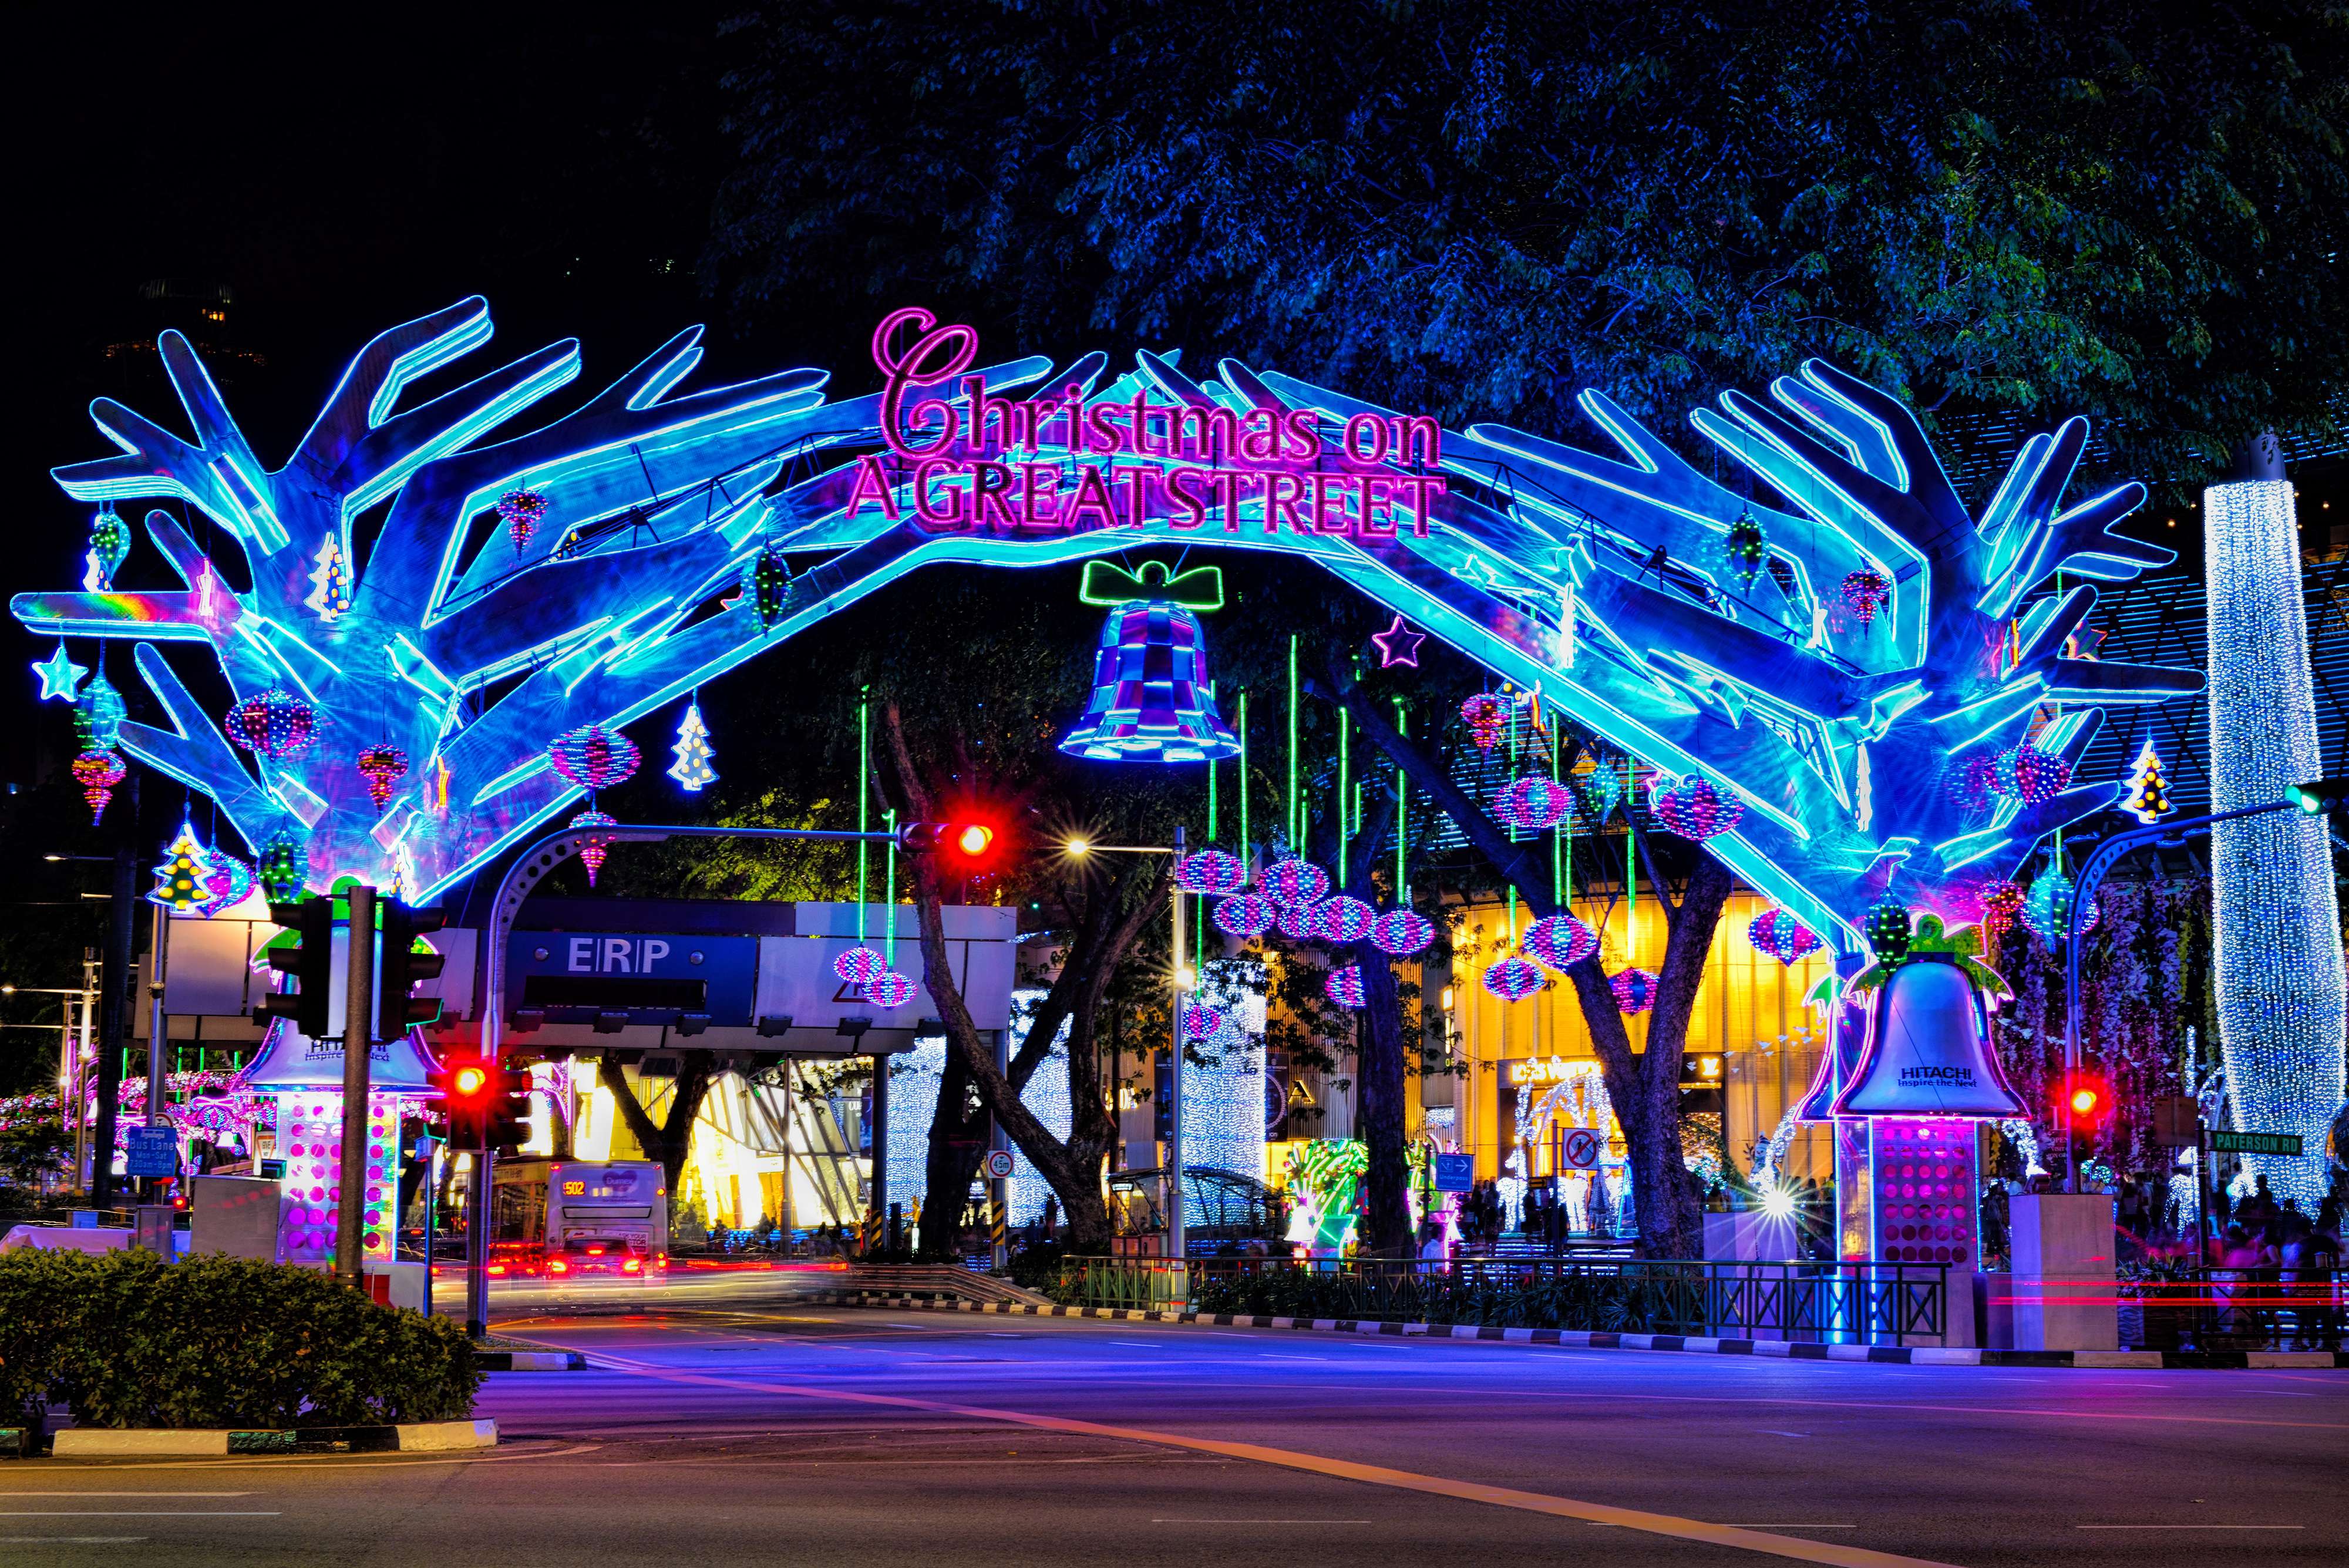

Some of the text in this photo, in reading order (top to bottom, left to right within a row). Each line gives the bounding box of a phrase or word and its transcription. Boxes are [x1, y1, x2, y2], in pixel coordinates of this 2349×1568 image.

[871, 306, 1441, 469] Christmas on
[843, 455, 901, 520] A
[1901, 1066, 1971, 1080] HITACHI
[1897, 1078, 1977, 1088] Inspire the Next
[129, 1138, 174, 1151] Bus Lane
[2216, 1133, 2298, 1152] PATERSON RD
[564, 1181, 585, 1196] 502
